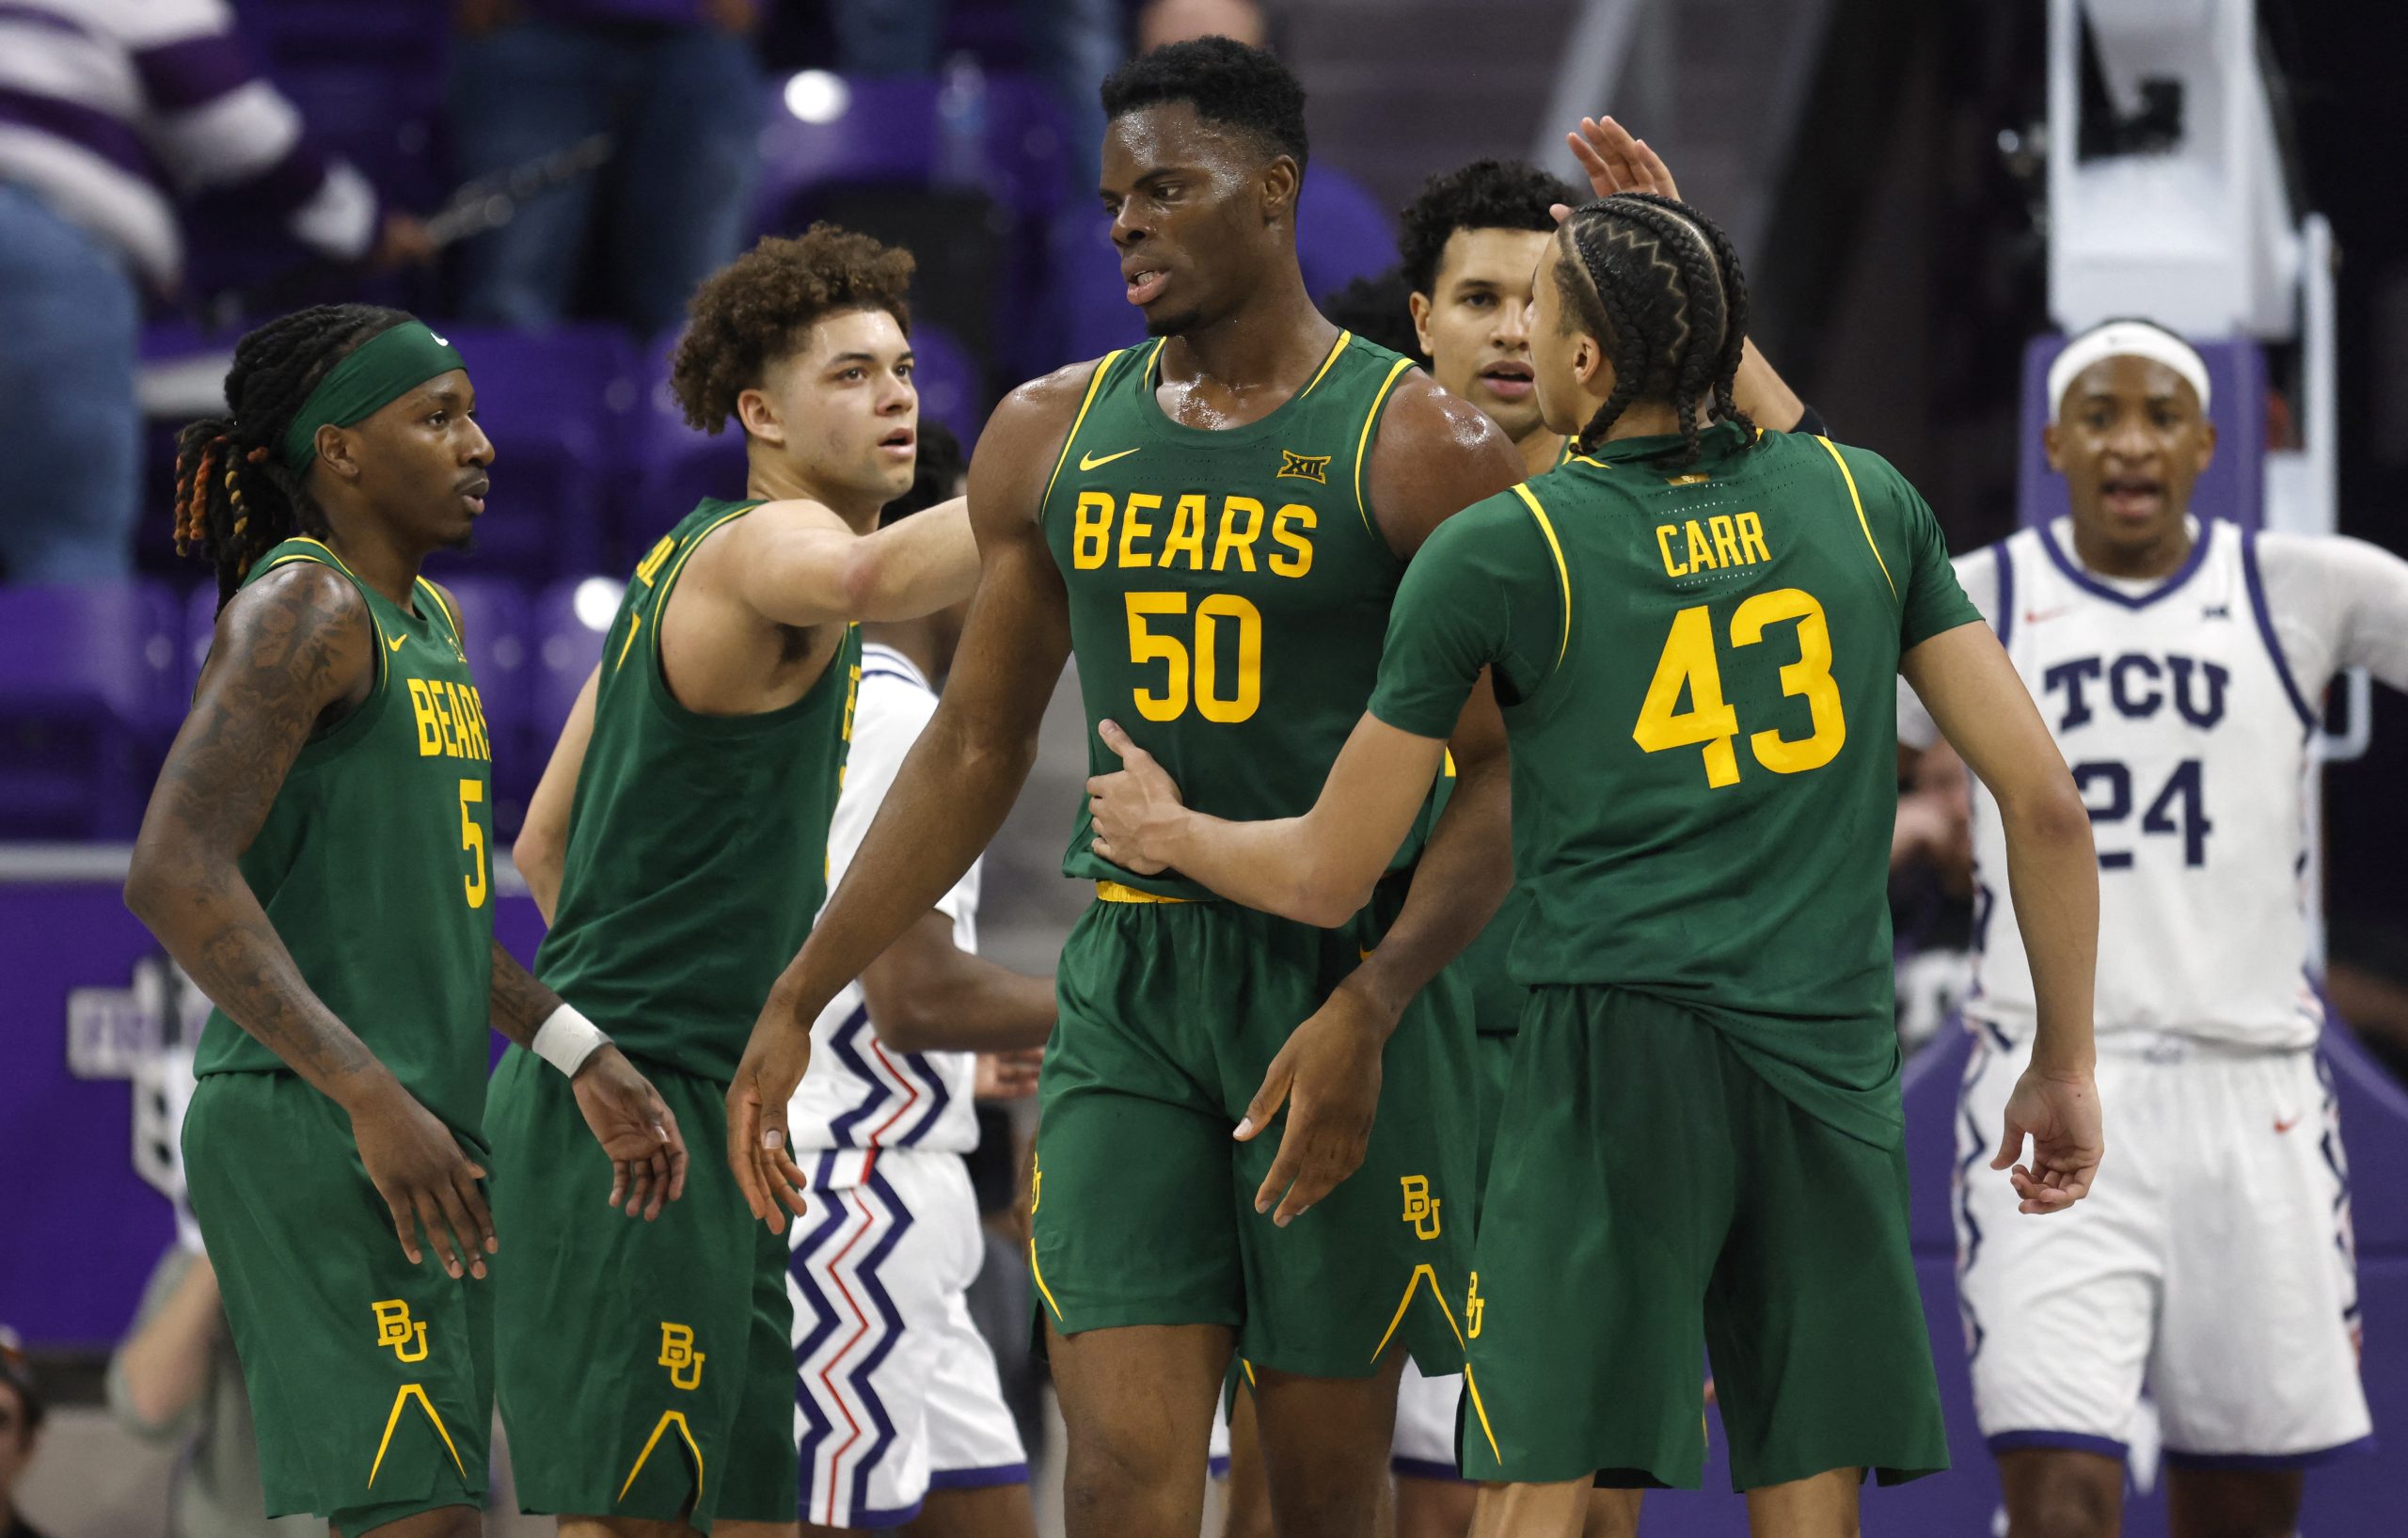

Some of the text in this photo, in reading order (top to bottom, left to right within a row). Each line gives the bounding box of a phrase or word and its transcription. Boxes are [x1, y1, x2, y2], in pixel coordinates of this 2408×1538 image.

[1073, 492, 1317, 579] BEARS
[1656, 511, 1772, 578] CARR
[1124, 592, 1261, 723] 50
[1632, 588, 1846, 789] 43
[2044, 653, 2229, 732] TCU
[459, 779, 486, 909] 5
[2071, 758, 2212, 869] 24
[1401, 1175, 1440, 1240] BU
[372, 1299, 428, 1363] BU
[1466, 1272, 1484, 1339] BU
[658, 1322, 705, 1390] BU
